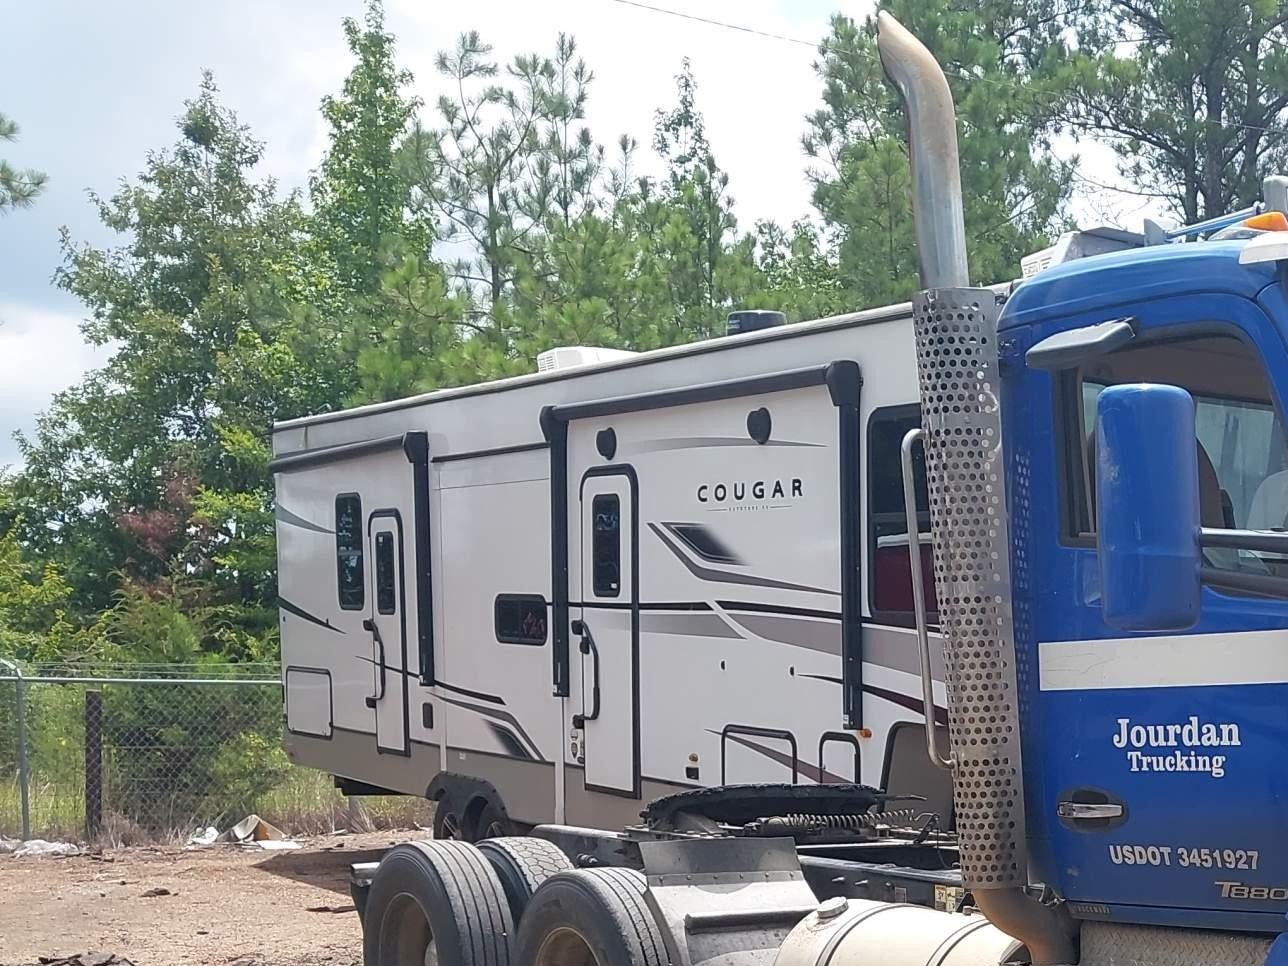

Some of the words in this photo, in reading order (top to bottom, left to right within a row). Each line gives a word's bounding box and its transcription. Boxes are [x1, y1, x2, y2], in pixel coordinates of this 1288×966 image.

[697, 478, 803, 502] COUGAR
[1113, 716, 1241, 748] Jourdan
[1127, 751, 1226, 778] Trucking
[1109, 845, 1171, 866] USDOT
[1177, 847, 1258, 870] 3451927
